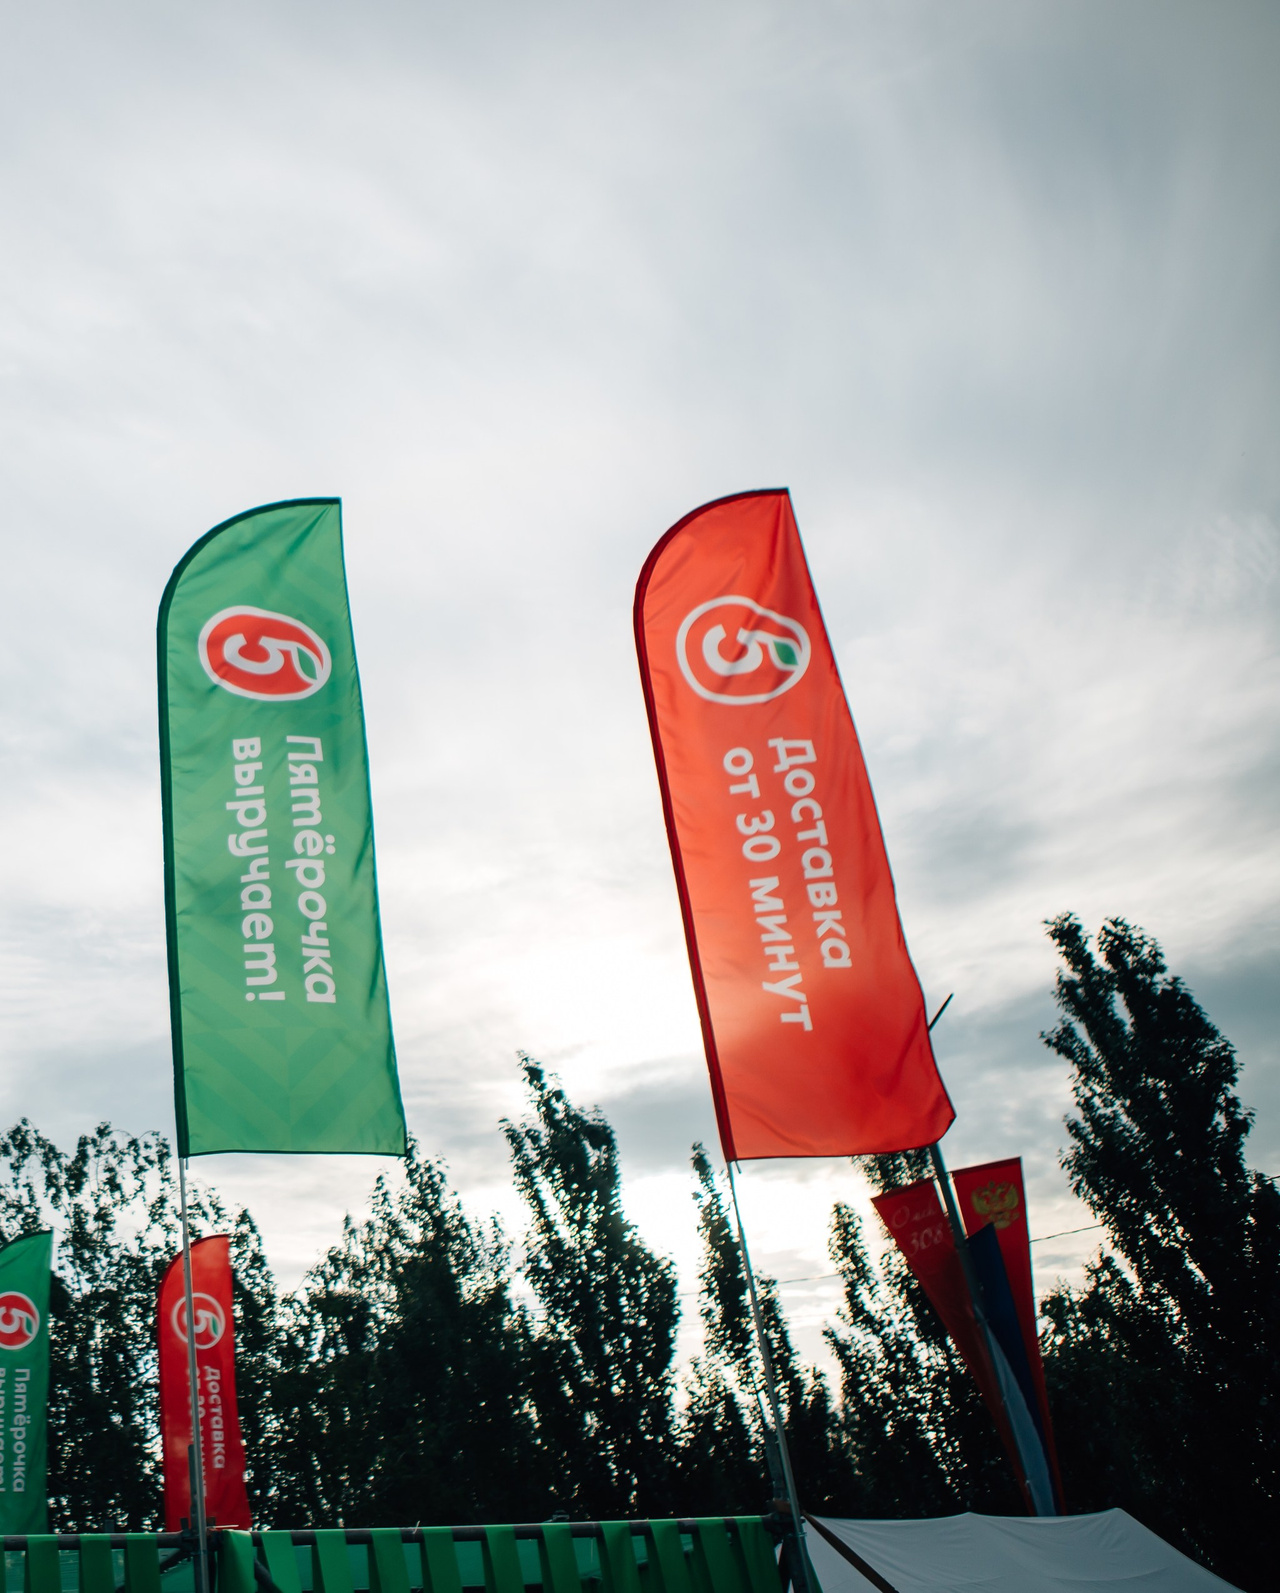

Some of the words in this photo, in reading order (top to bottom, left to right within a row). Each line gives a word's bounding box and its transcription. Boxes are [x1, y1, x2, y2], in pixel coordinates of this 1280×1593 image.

[723, 747, 761, 799] от
[735, 810, 781, 862] 30
[227, 737, 285, 1002] выручает!
[286, 734, 337, 1004] Пятёрочка
[767, 737, 852, 968] Доставка
[749, 875, 813, 1031] минут
[13, 1368, 37, 1493] Пятёрочка
[204, 1365, 225, 1470] Доставка
